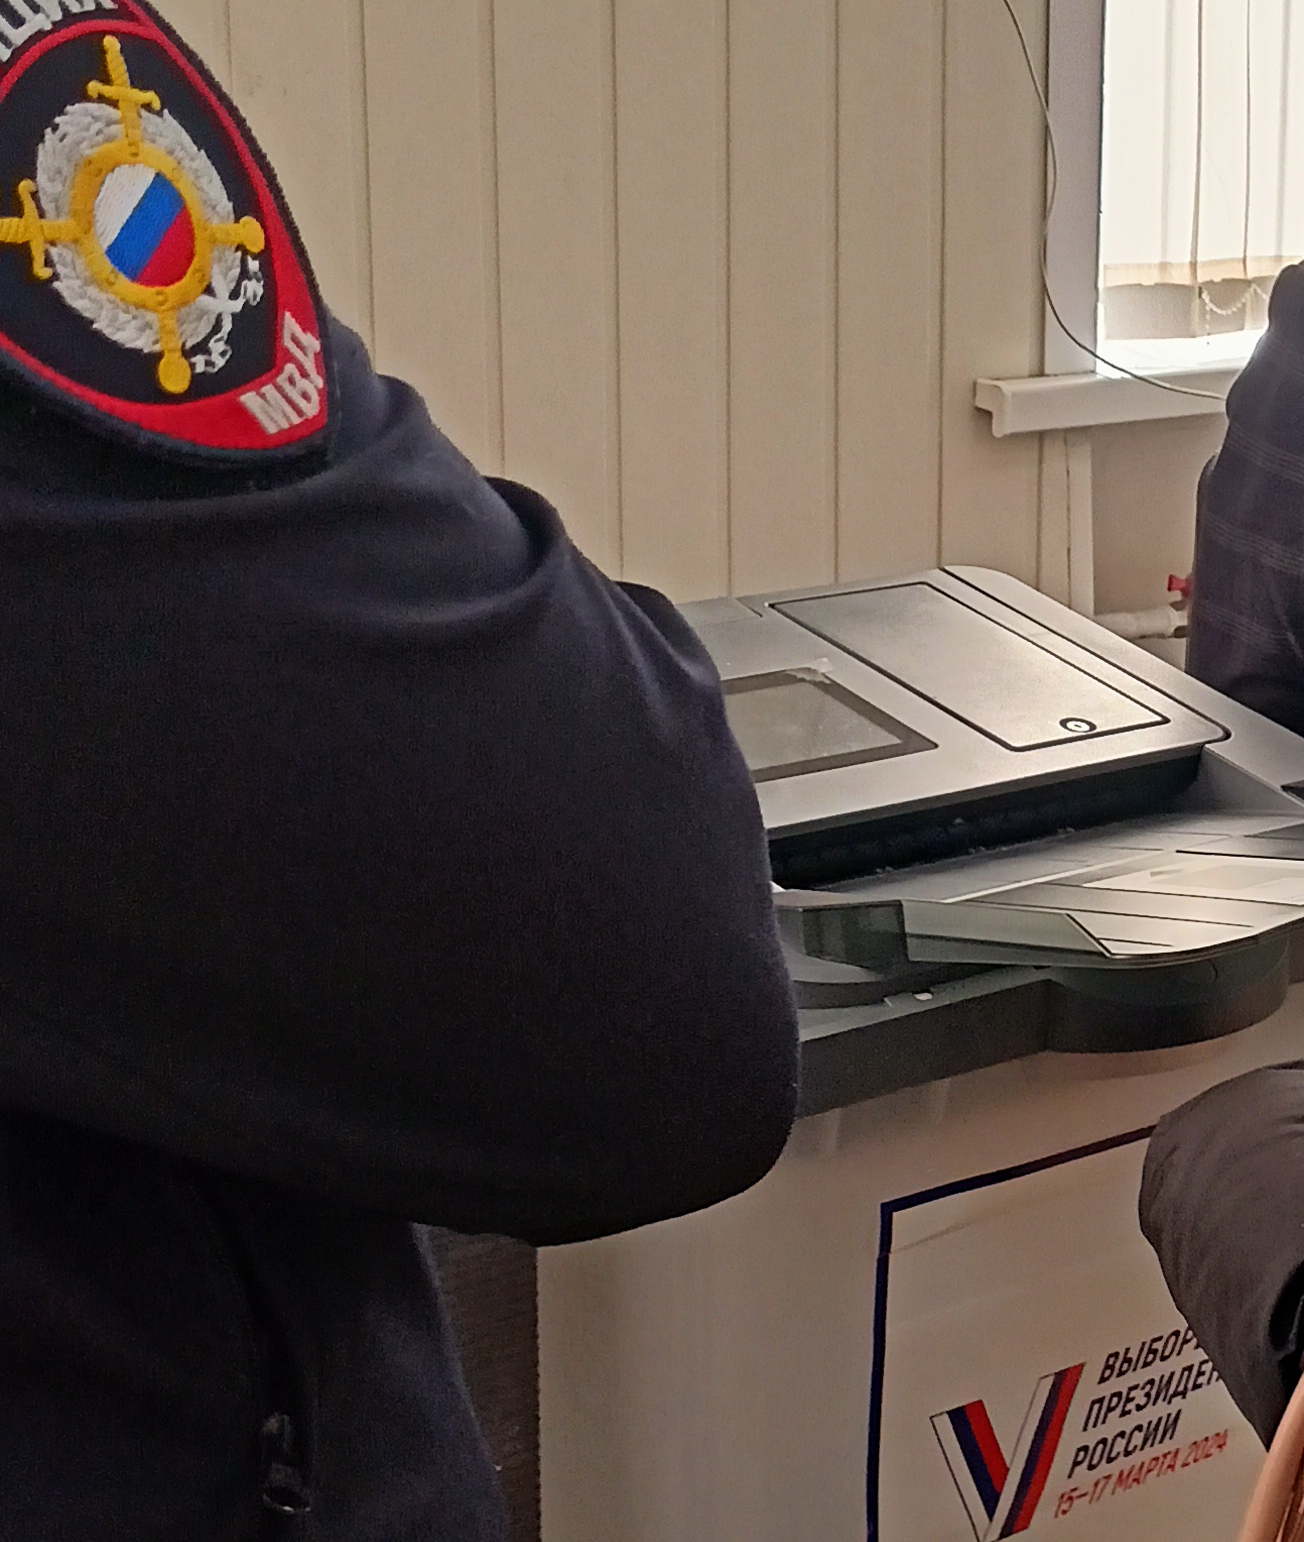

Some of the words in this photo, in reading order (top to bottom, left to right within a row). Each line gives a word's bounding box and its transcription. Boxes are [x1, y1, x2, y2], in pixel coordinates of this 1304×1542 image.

[240, 310, 324, 435] МВД
[1097, 1327, 1200, 1385] ВЫБОР
[1067, 1408, 1183, 1479] РОССИИ
[1111, 1448, 1181, 1496] МАРТА
[1180, 1429, 1229, 1469] 2024
